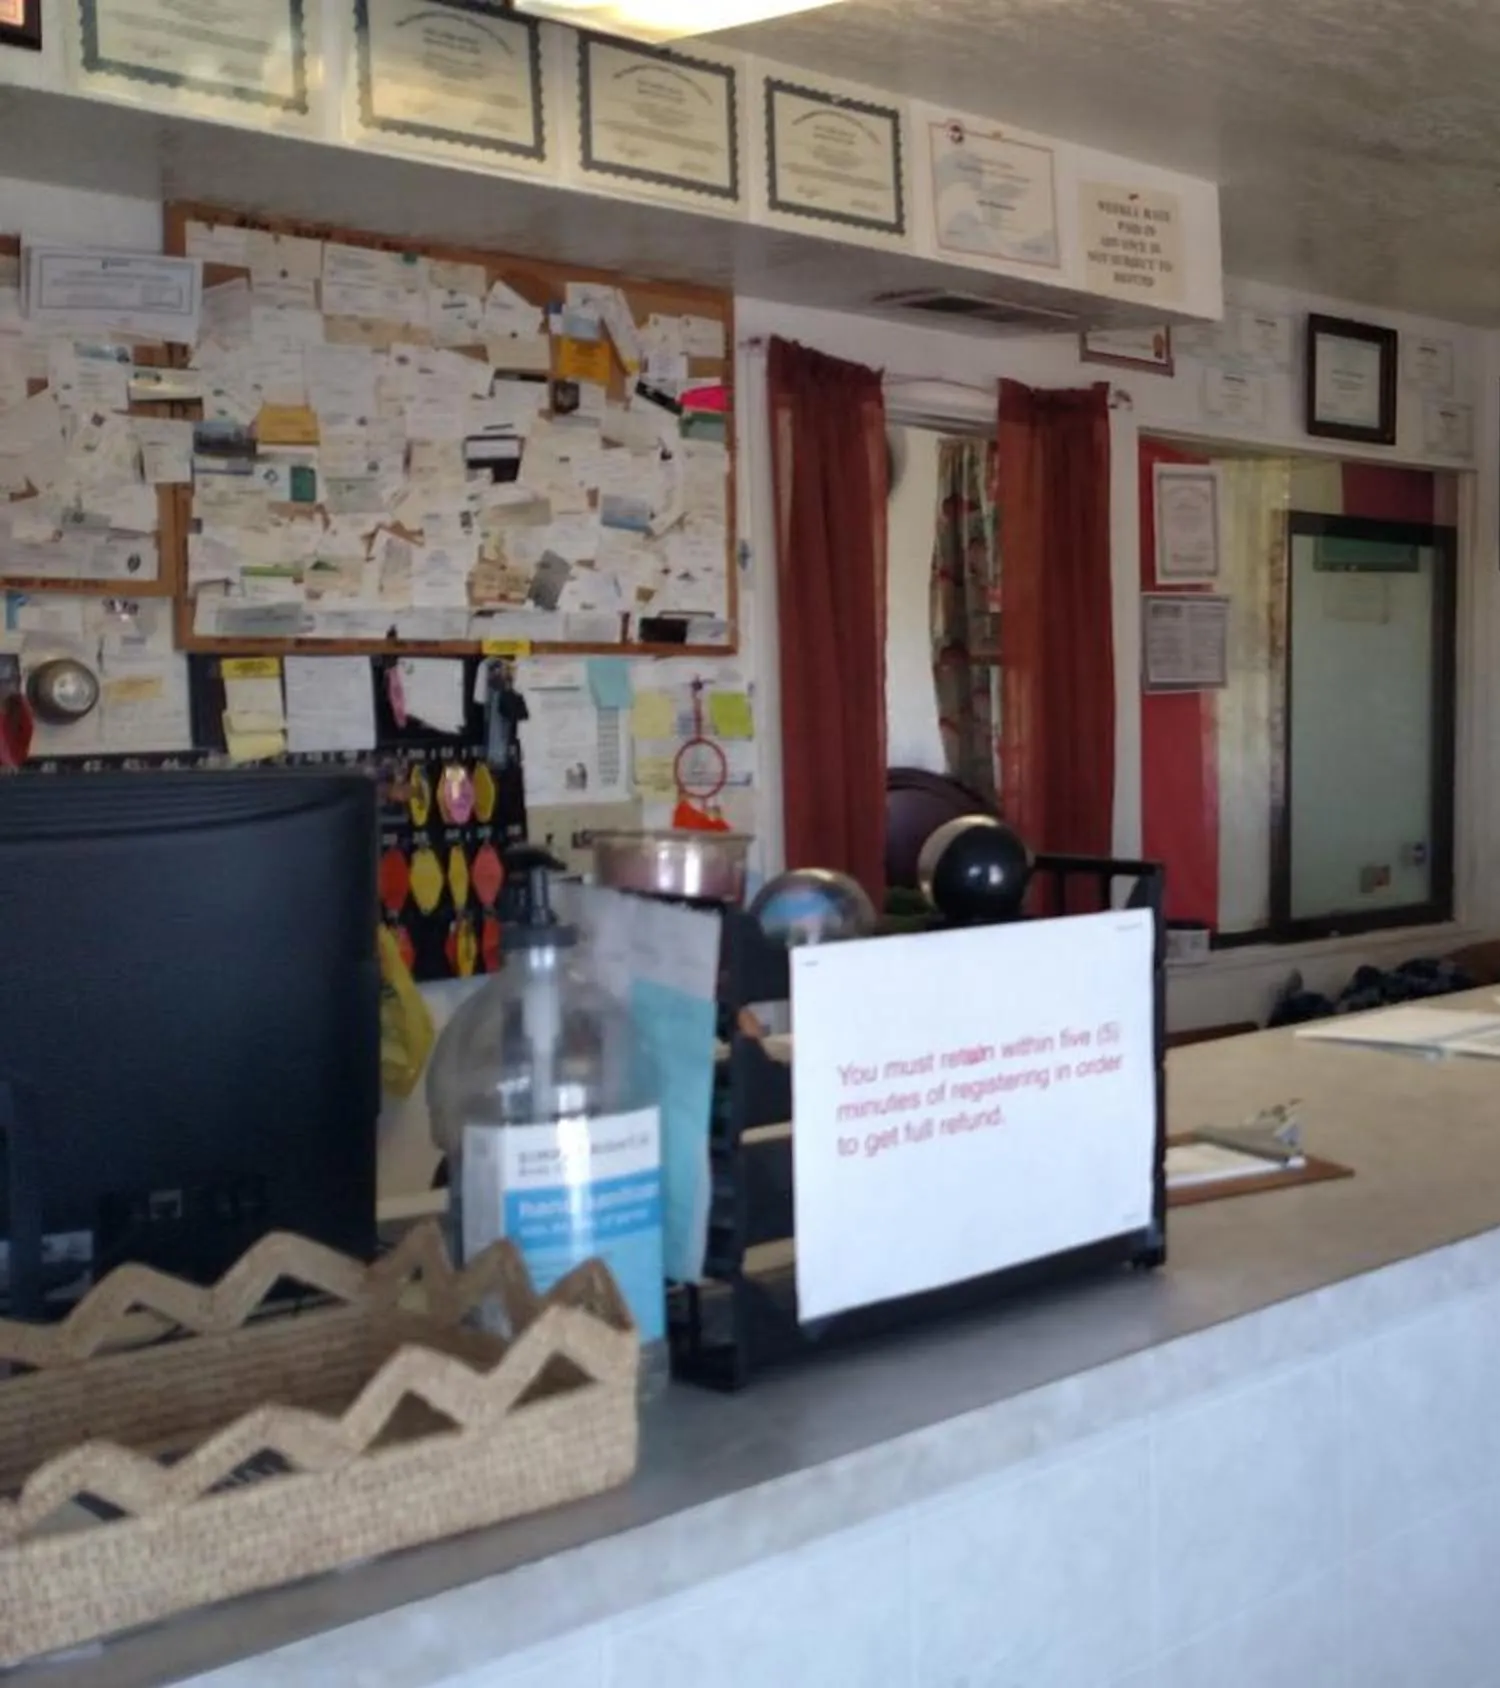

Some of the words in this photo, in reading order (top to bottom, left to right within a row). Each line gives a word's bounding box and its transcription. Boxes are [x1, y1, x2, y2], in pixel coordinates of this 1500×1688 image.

[836, 1092, 921, 1120] minutes
[926, 1081, 947, 1107] of
[951, 1066, 1050, 1102] registering
[1054, 1062, 1072, 1081] in
[1075, 1052, 1124, 1079] order
[837, 1063, 878, 1086] You
[882, 1053, 935, 1080] must
[1001, 1033, 1055, 1058] within
[1059, 1026, 1092, 1047] five
[1096, 1021, 1121, 1044] (5)
[836, 1133, 859, 1157] to
[864, 1124, 900, 1157] get
[903, 1116, 935, 1144] full
[940, 1105, 1005, 1135] refund.
